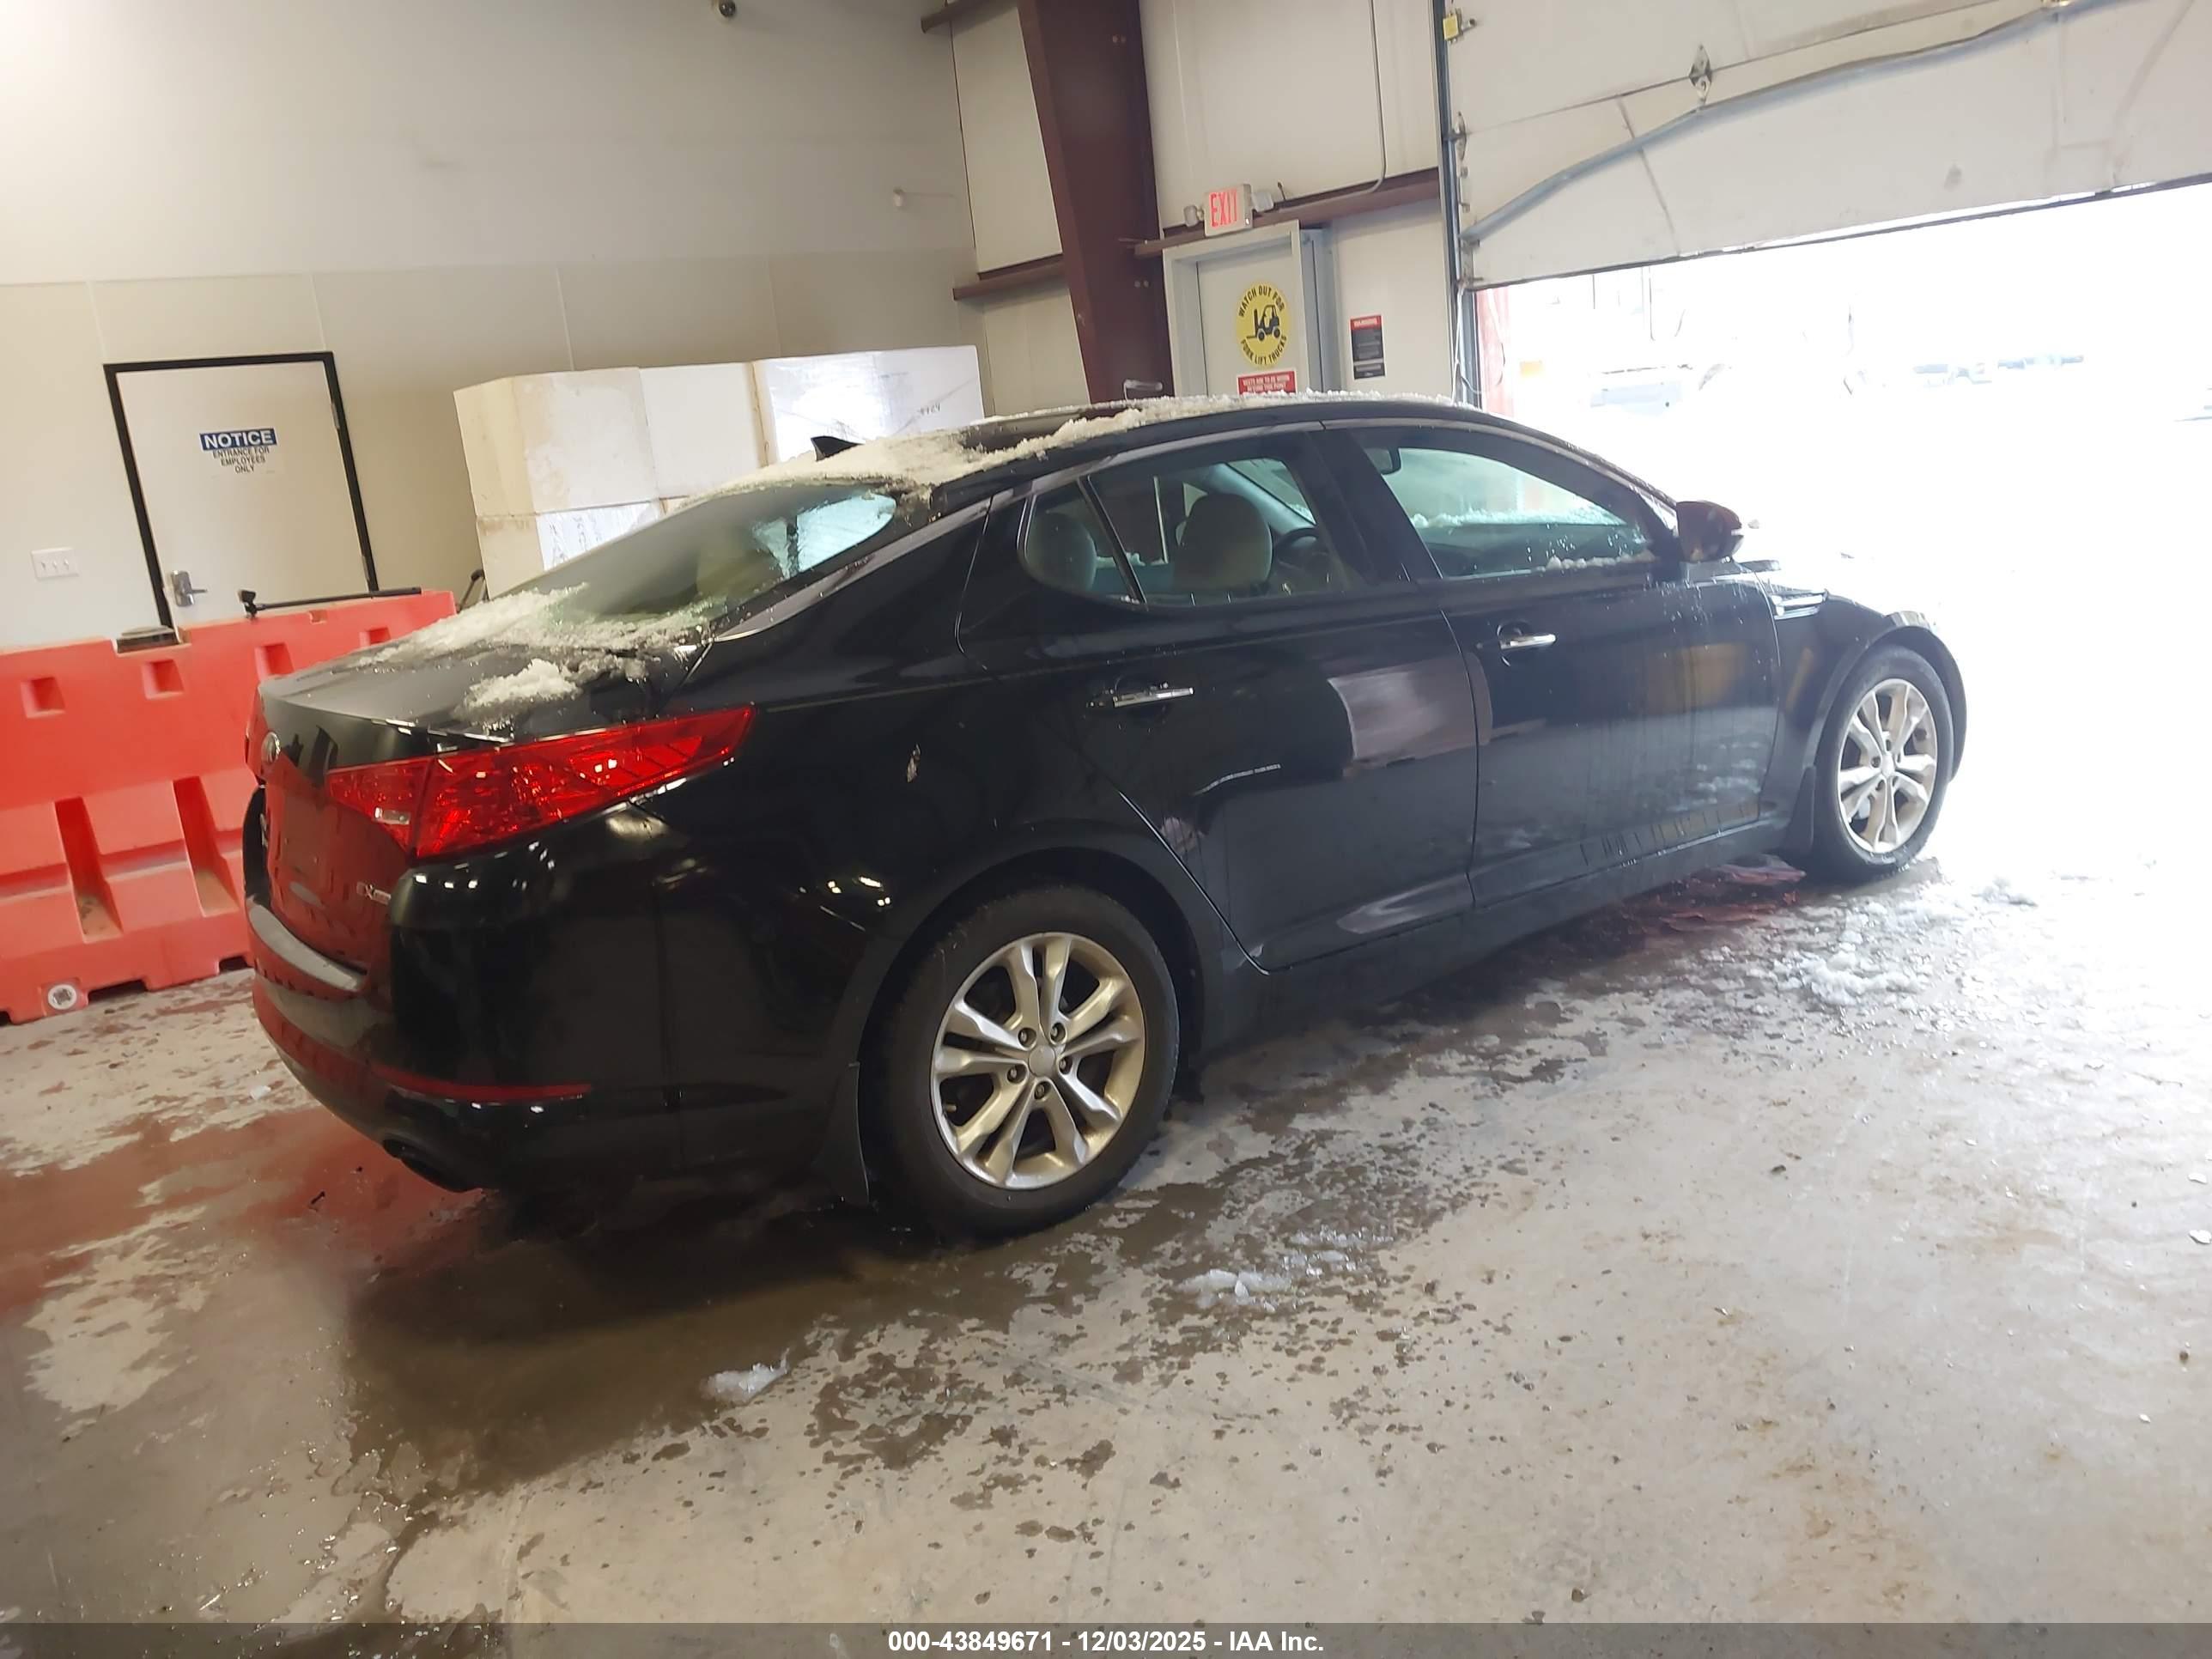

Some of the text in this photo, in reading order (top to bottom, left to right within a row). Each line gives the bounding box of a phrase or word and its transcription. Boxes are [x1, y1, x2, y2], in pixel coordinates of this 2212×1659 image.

[1209, 188, 1237, 228] EXIT
[1238, 284, 1285, 318] WATCH OUT FOR
[1241, 335, 1287, 365] FORK LIFT TRUCKS
[204, 429, 274, 449] NOTICE
[212, 446, 270, 459] ENTRANCE FOR
[221, 454, 265, 466] EMPLOYEES
[234, 465, 254, 473] ONLY
